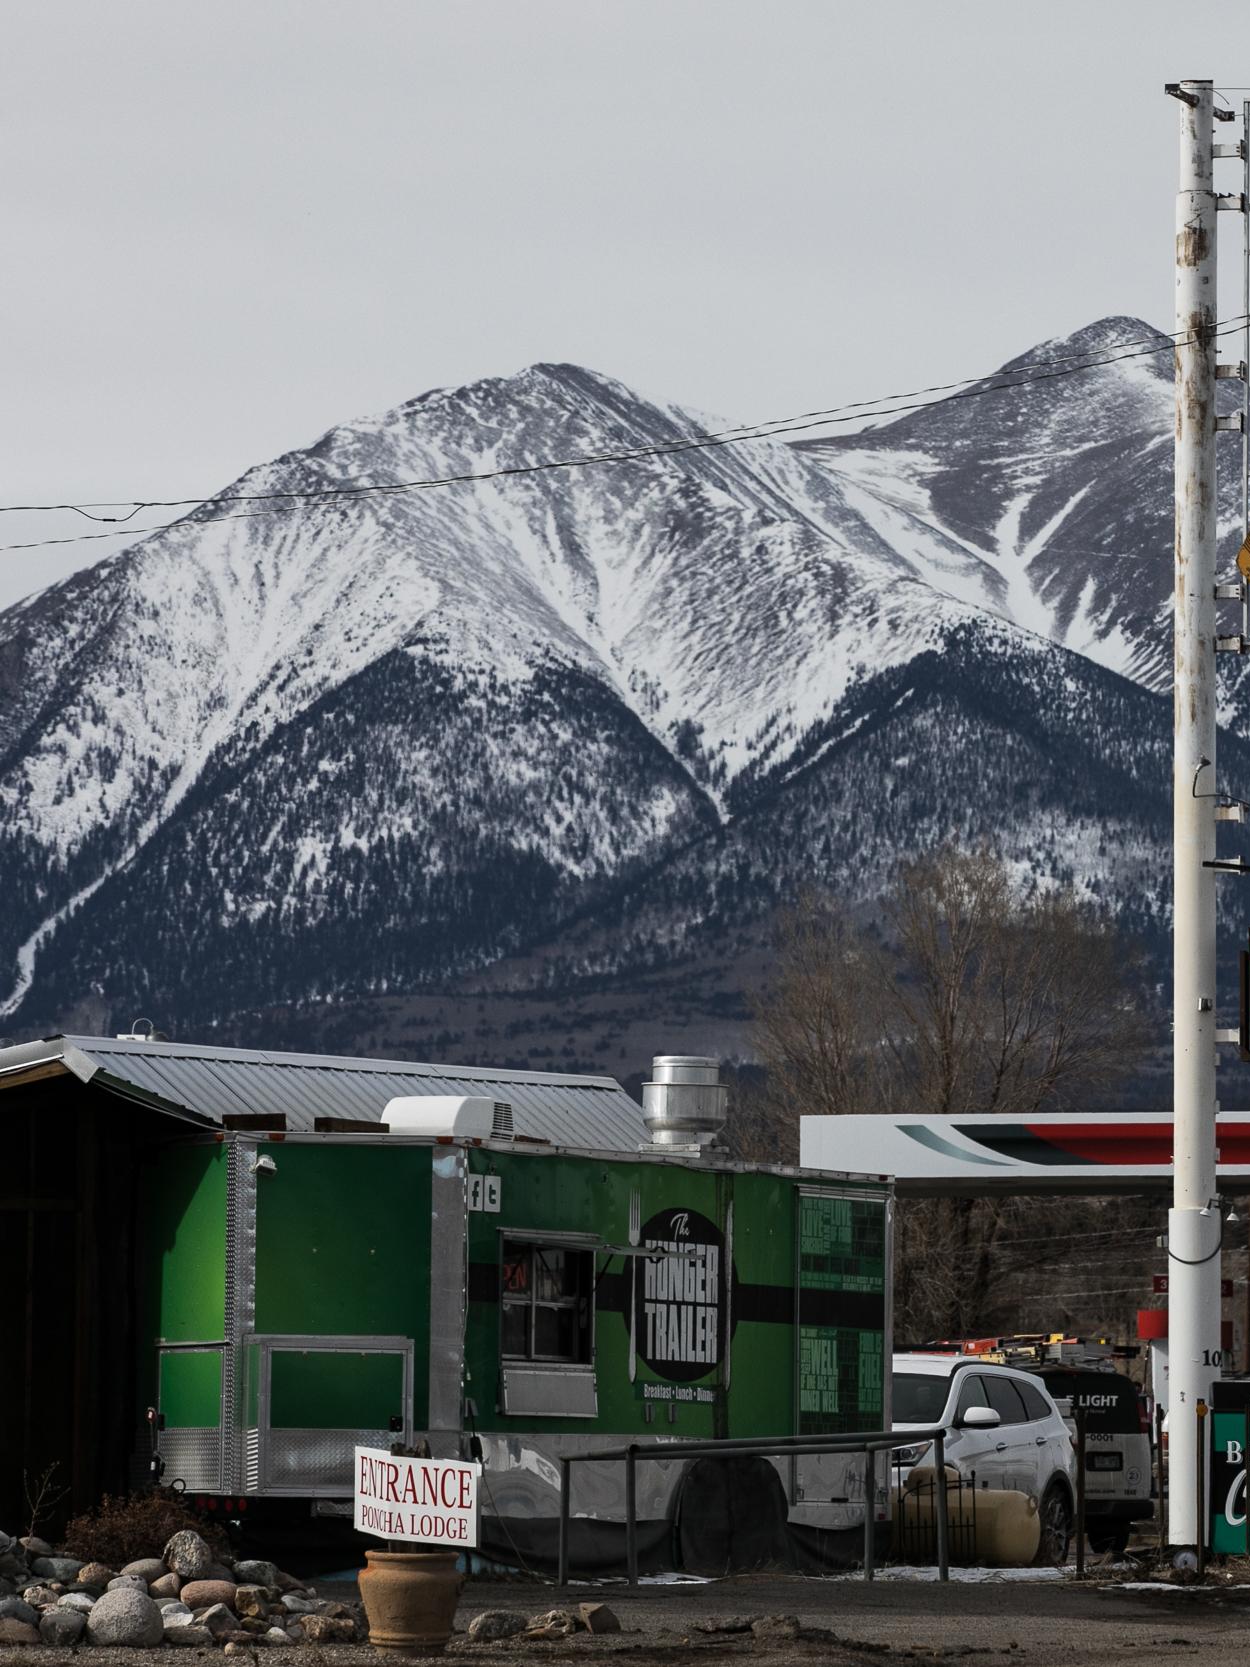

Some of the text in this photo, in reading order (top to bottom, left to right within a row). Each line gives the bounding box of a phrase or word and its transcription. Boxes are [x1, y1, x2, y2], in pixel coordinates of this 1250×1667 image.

[670, 1213, 689, 1241] The
[644, 1239, 719, 1305] HUNGER
[1160, 1279, 1167, 1289] 3
[644, 1302, 718, 1364] TRAILER
[811, 1339, 839, 1376] WELL
[1202, 1350, 1222, 1367] 10
[644, 1384, 672, 1398] Breakfast
[676, 1386, 693, 1400] Lunch
[1079, 1395, 1119, 1407] LIGHT
[360, 1455, 473, 1509] ENTRANCE
[362, 1504, 468, 1540] PONCHA LODGE
